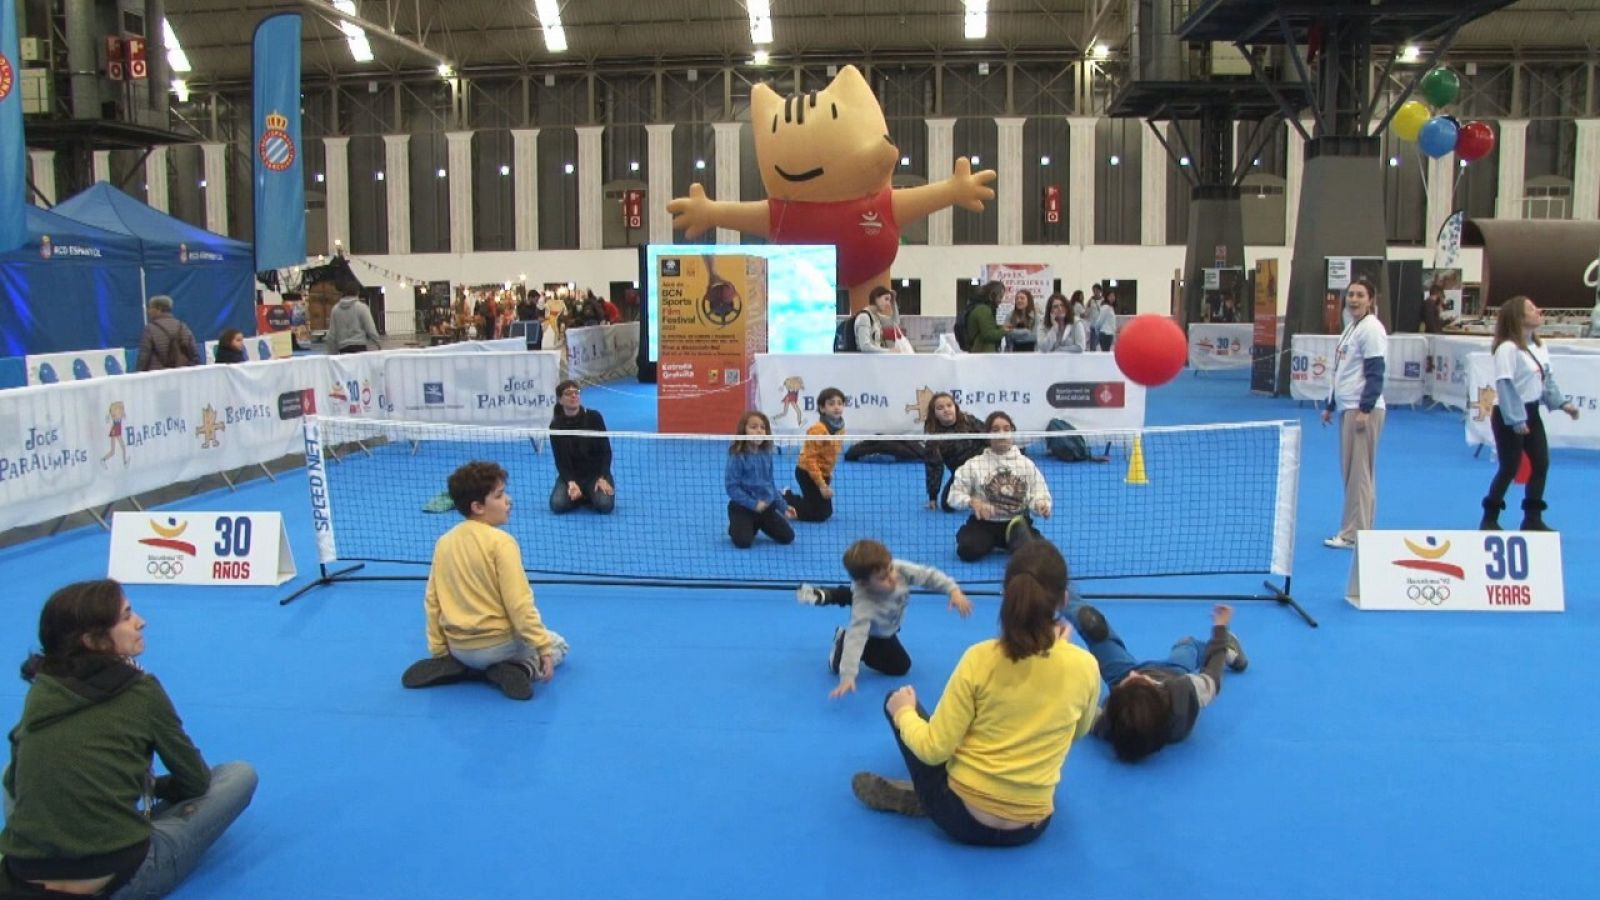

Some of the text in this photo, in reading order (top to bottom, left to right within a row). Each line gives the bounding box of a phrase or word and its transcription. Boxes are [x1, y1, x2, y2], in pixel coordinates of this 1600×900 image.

[662, 289, 682, 297] BCN
[662, 298, 692, 308] Sports
[662, 307, 680, 316] Film
[662, 316, 695, 325] Festival
[1292, 355, 1309, 371] 30
[303, 427, 329, 532] SPEED NET
[215, 516, 252, 557] 30
[1484, 535, 1529, 581] 30
[212, 561, 250, 580] AÑOS
[1486, 585, 1531, 605] YEARS
